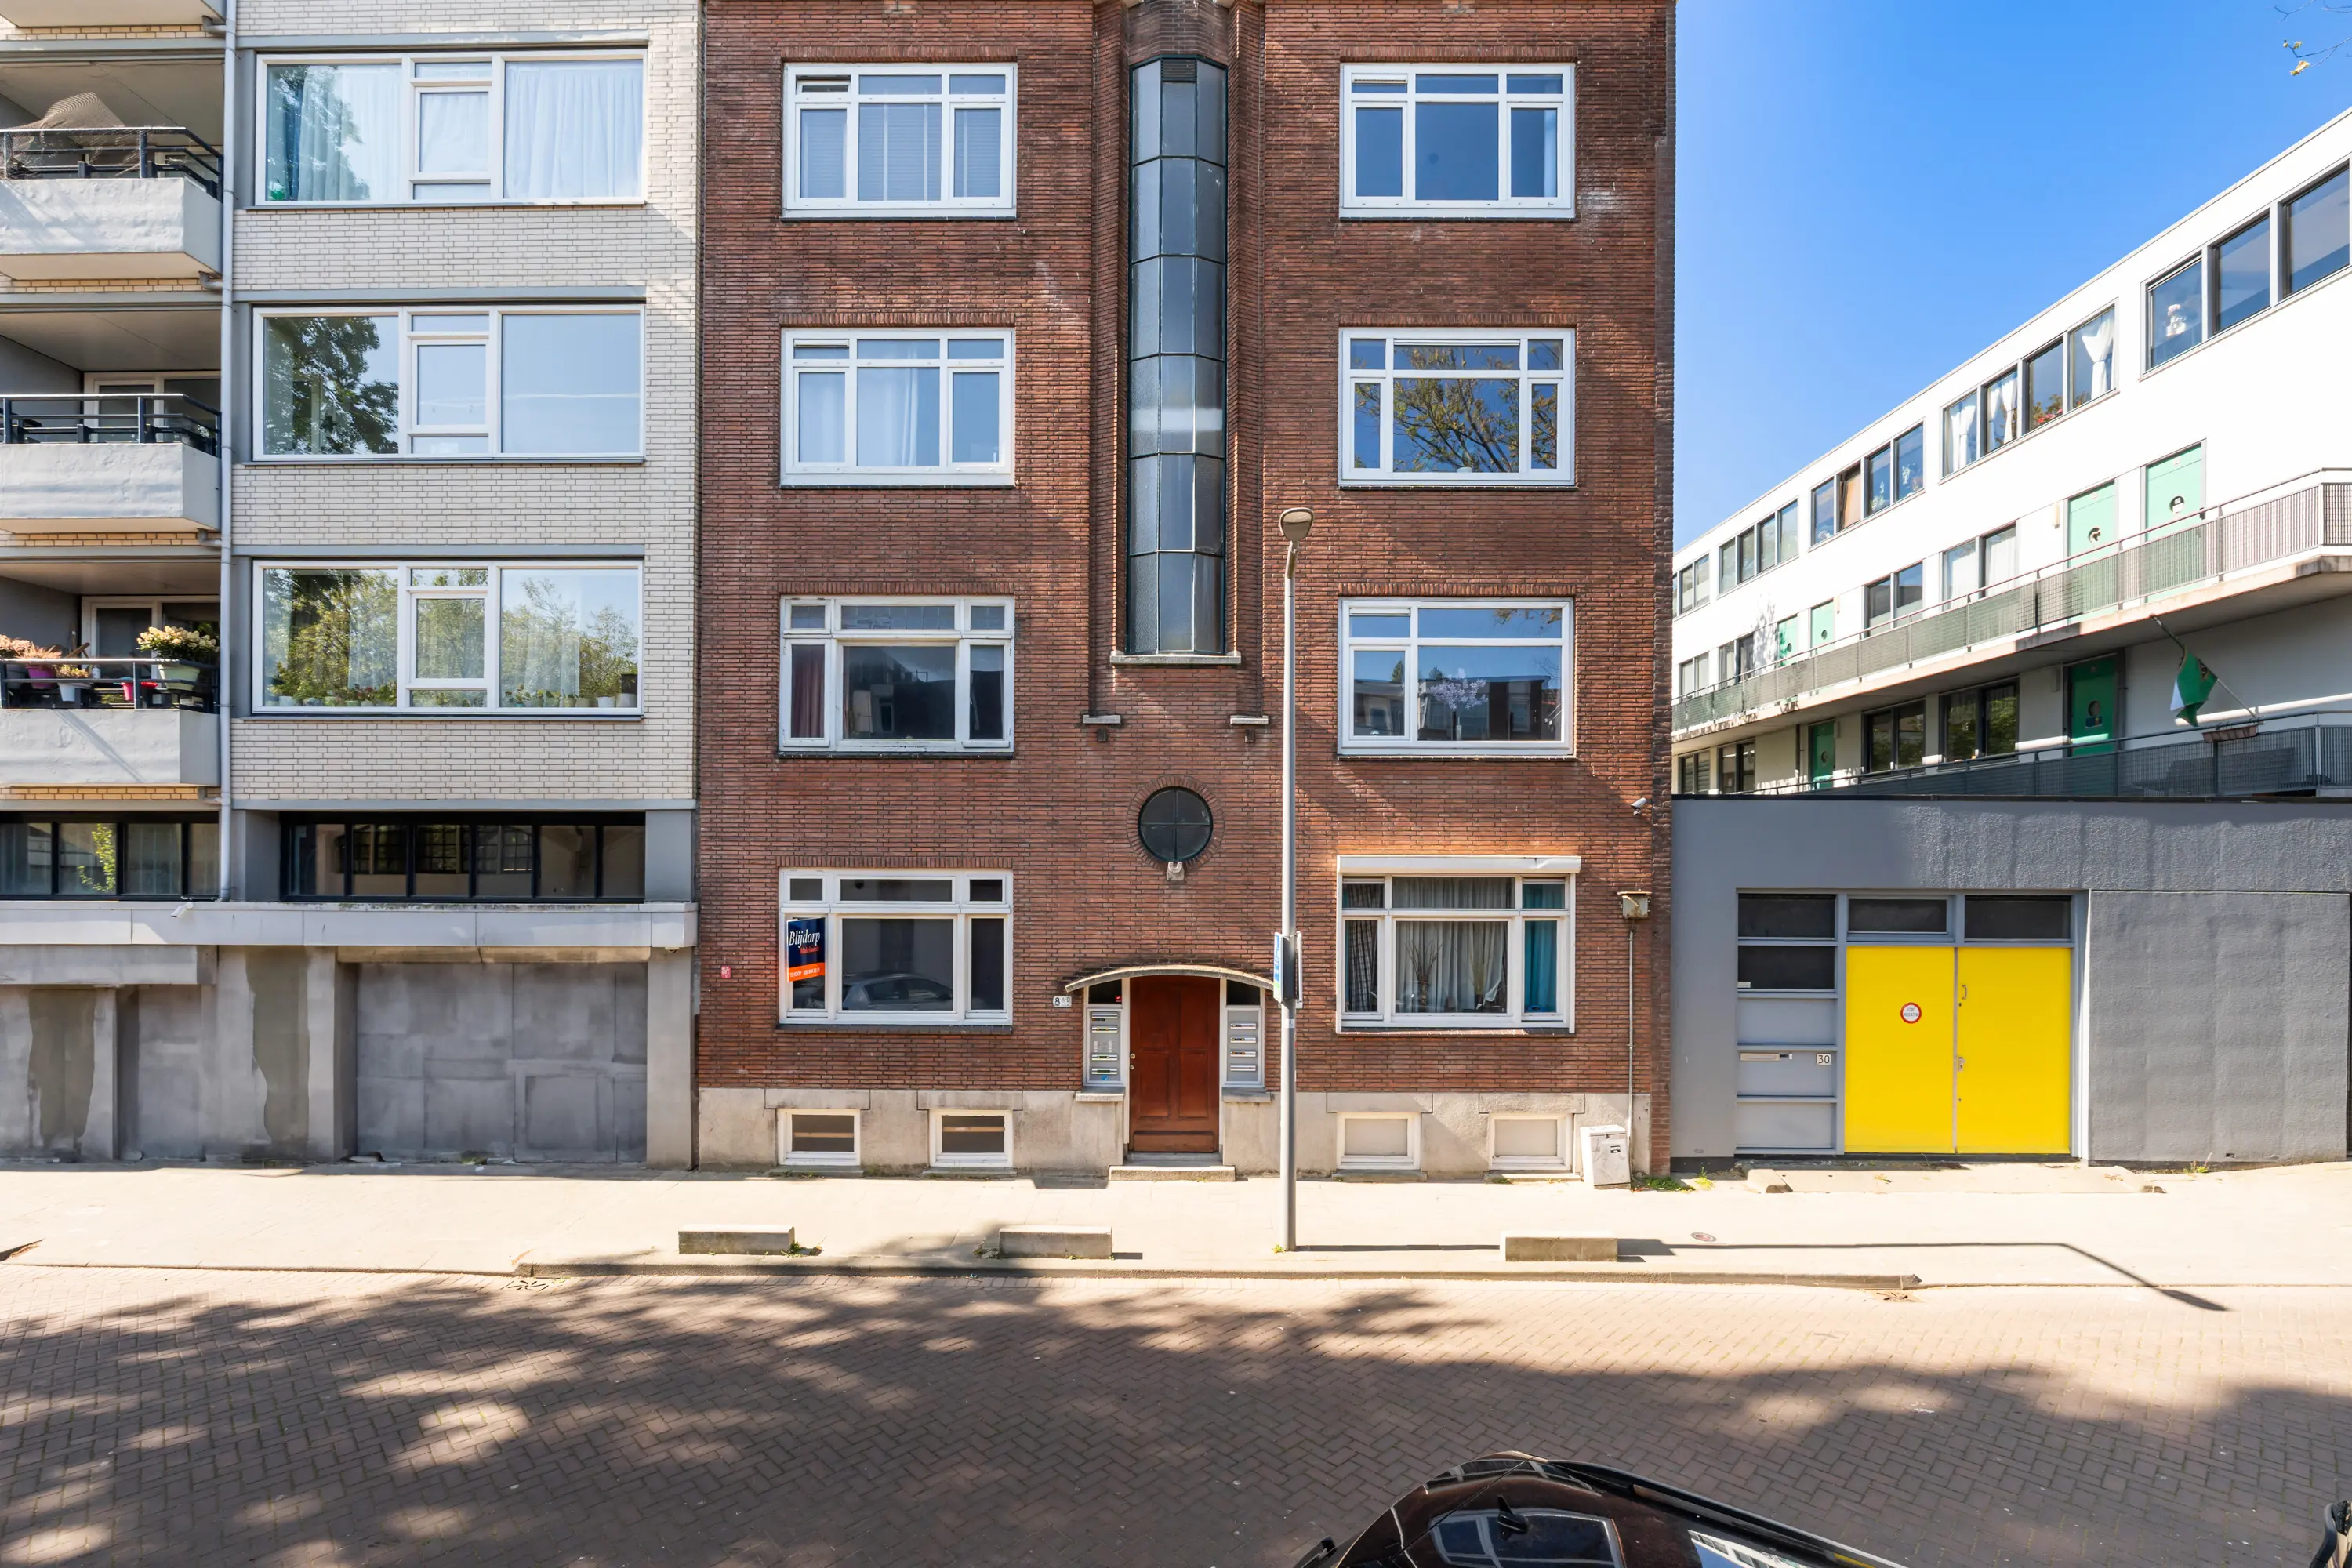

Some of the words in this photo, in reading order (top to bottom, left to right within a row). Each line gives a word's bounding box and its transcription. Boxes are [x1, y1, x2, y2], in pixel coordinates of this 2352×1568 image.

[789, 929, 821, 948] Blijdorp
[1054, 997, 1060, 1006] 8
[1818, 1054, 1830, 1064] 30
